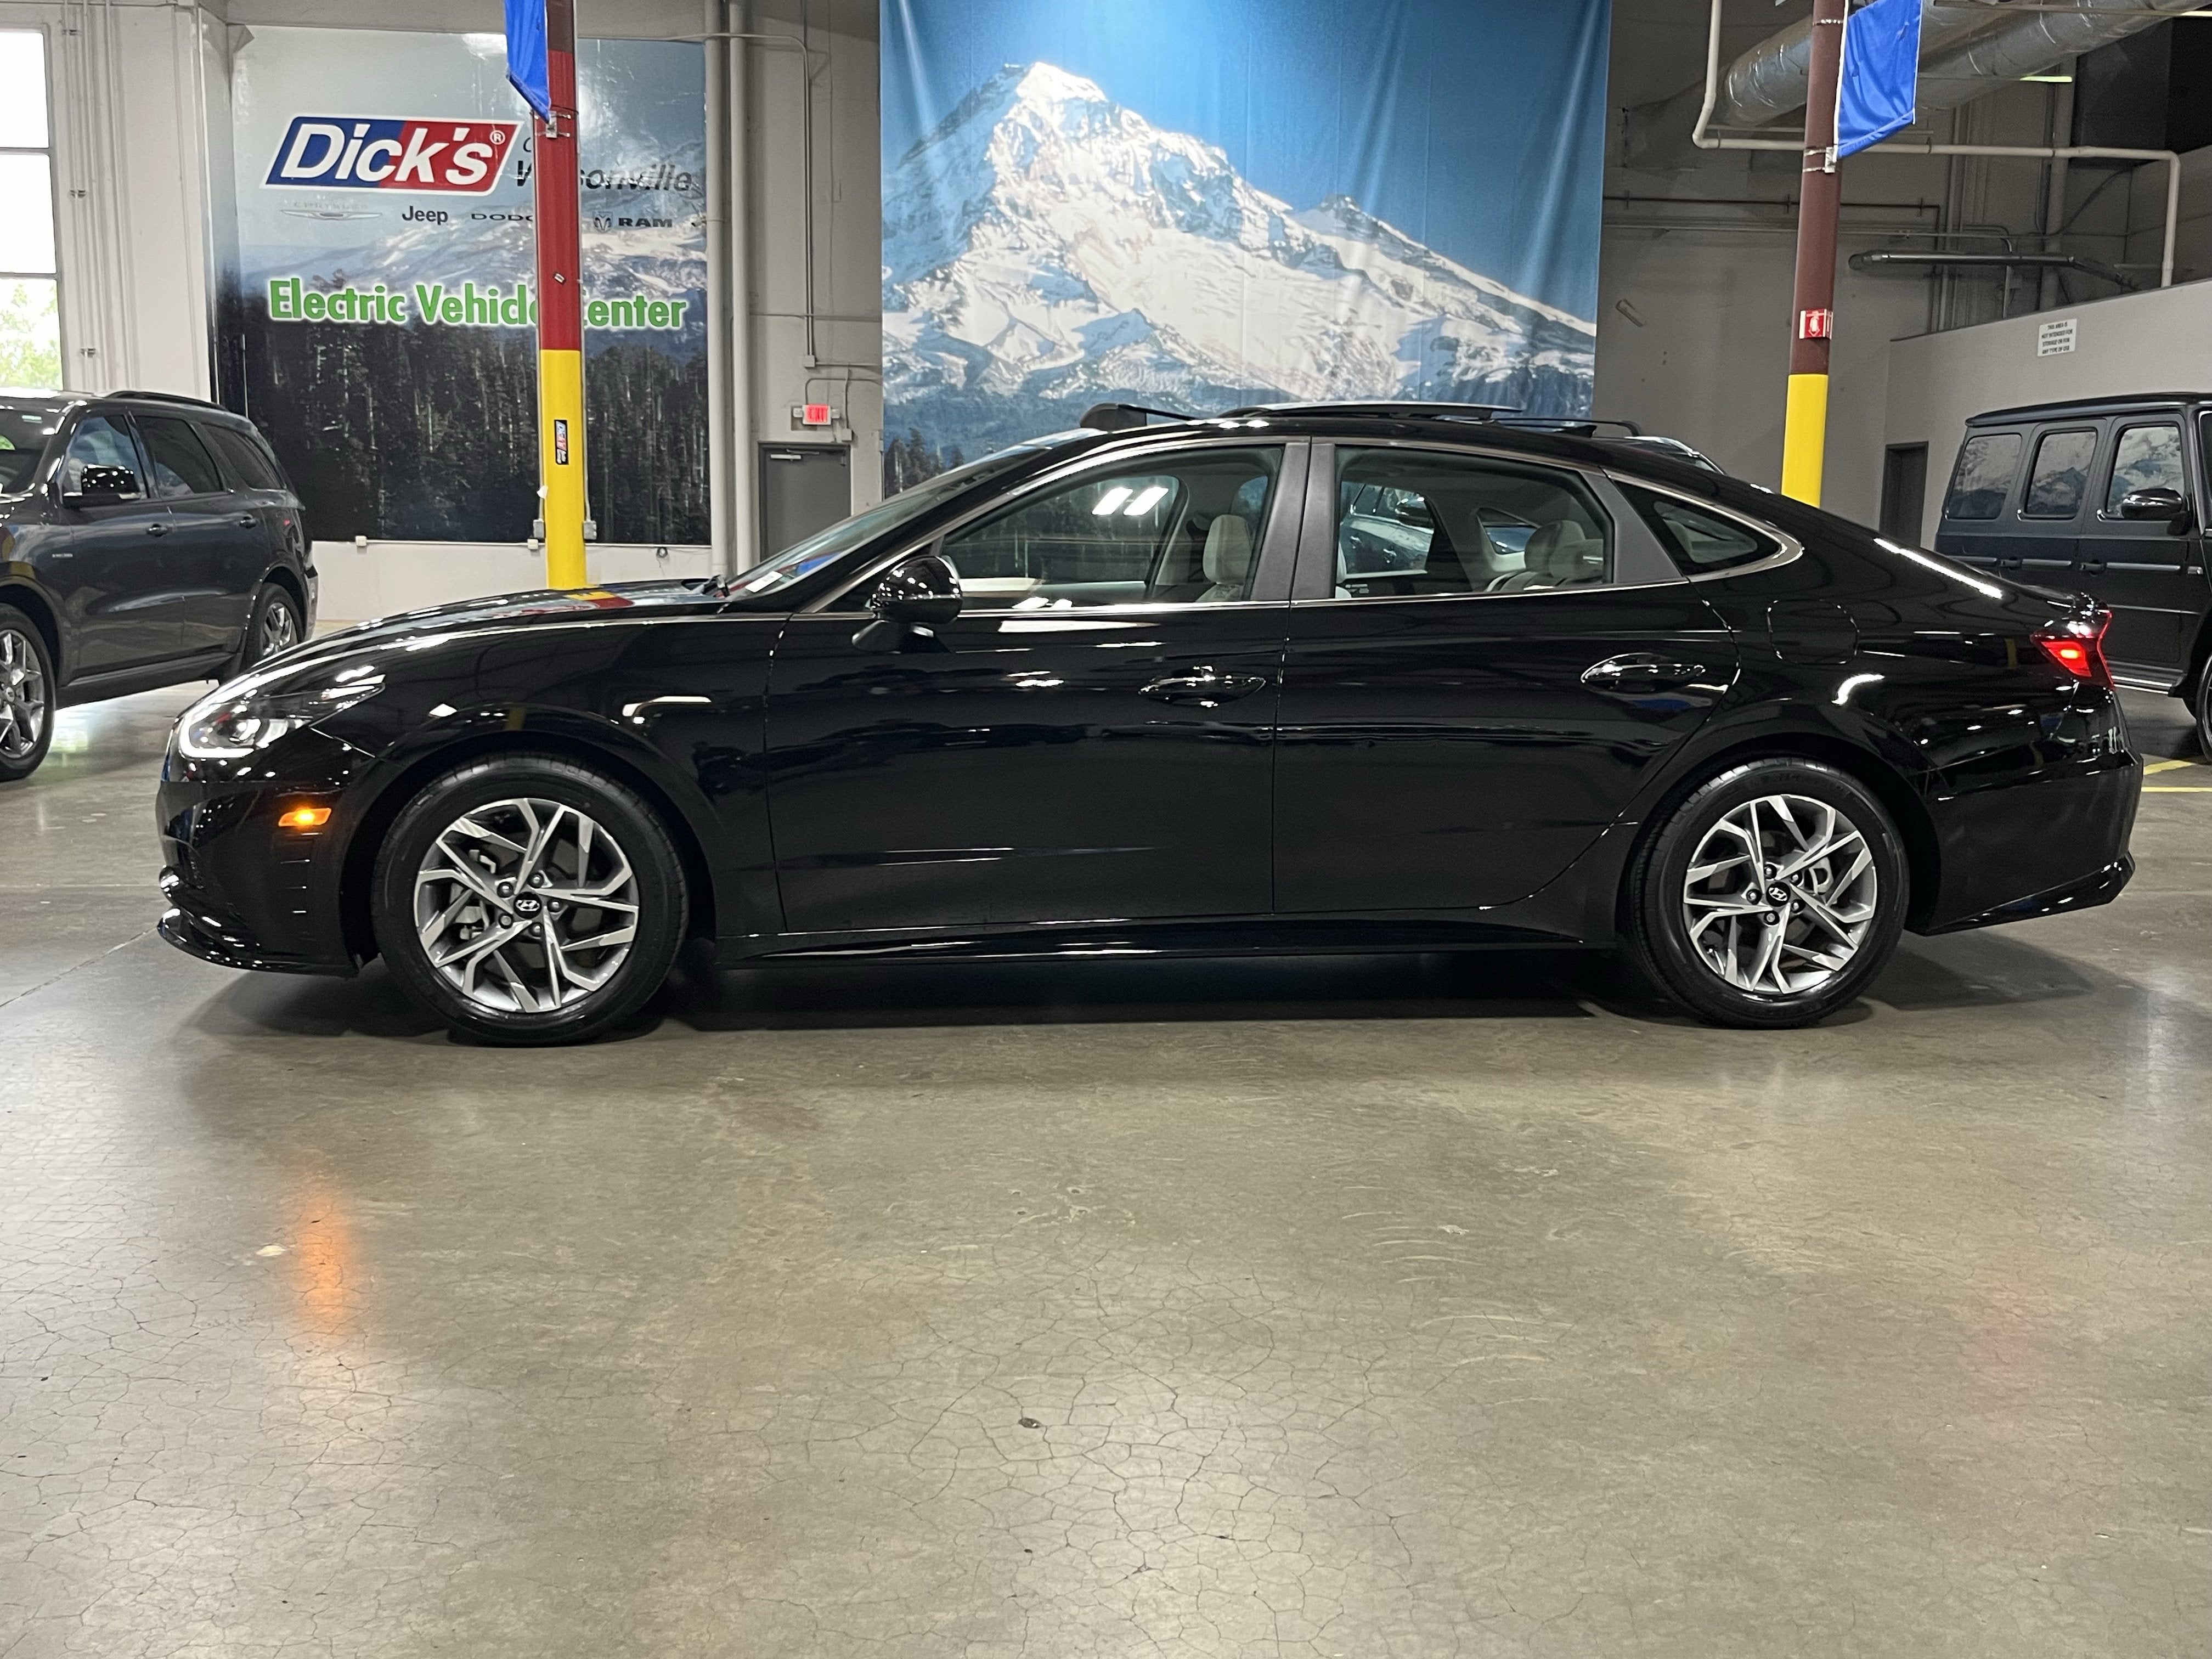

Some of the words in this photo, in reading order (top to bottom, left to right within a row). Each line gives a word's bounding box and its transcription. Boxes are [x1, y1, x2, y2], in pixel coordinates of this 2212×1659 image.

[402, 206, 448, 225] Jeep
[618, 218, 673, 228] RAM
[270, 278, 406, 322] Electric
[583, 289, 686, 327] enter
